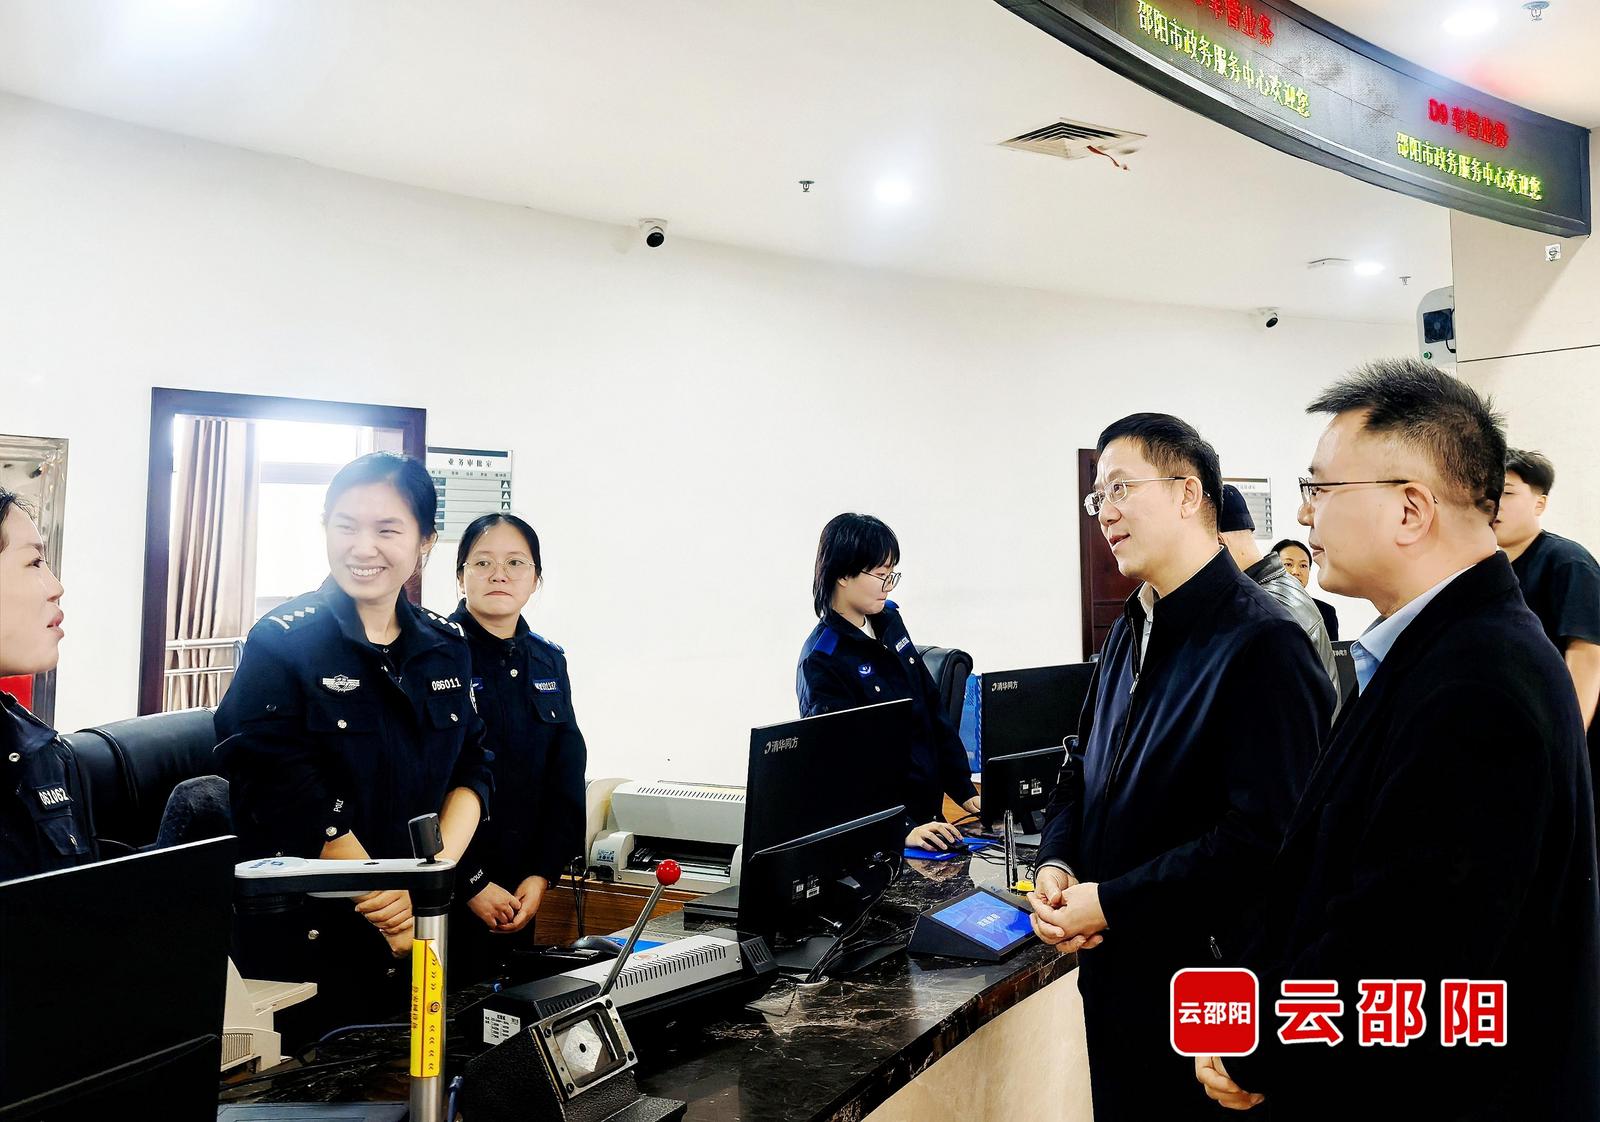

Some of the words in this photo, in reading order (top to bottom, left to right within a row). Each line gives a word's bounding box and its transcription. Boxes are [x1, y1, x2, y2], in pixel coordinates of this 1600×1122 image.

[1137, 0, 1311, 118] 邵阳市政务服务中心欢迎您
[1452, 107, 1508, 148] 车管业务
[1396, 131, 1543, 201] 邵阳市政务服务中心欢迎您
[431, 678, 461, 691] 066011
[771, 737, 799, 753] 清华同方
